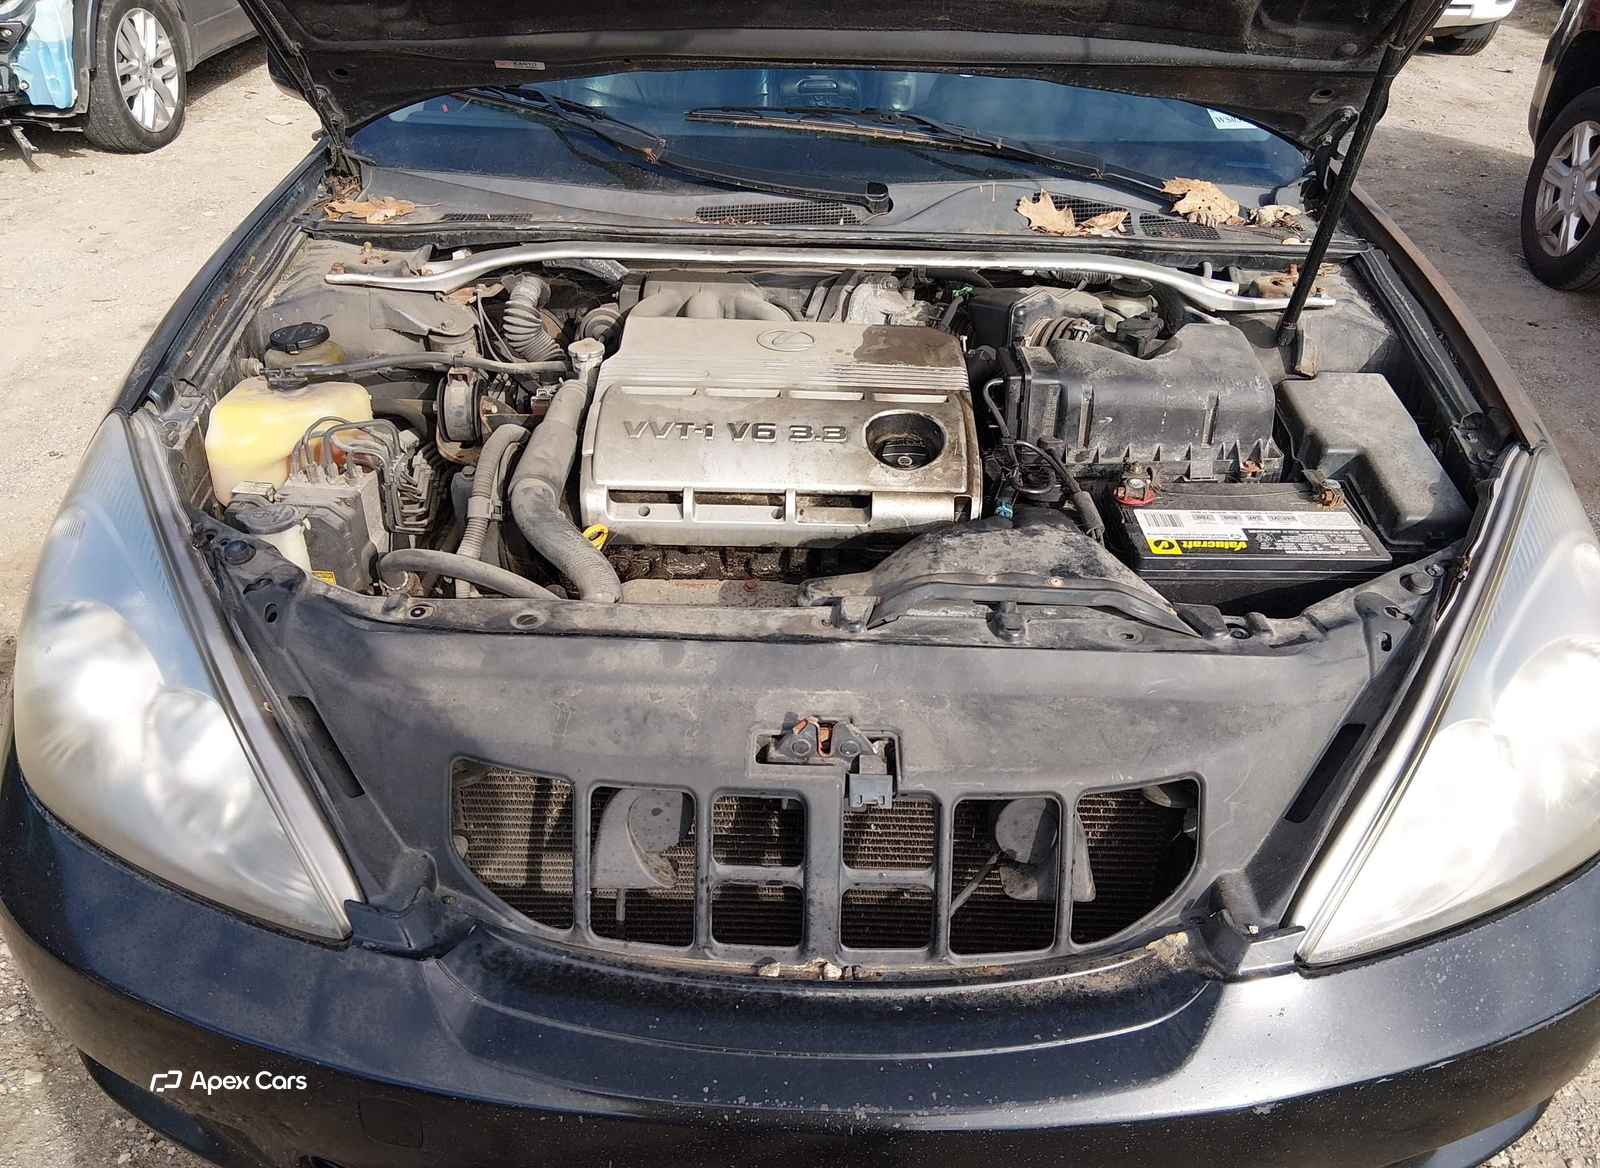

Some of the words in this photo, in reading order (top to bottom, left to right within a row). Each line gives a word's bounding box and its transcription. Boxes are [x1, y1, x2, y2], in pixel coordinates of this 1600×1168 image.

[727, 421, 777, 443] V6
[789, 424, 848, 443] 3.3
[1182, 541, 1248, 552] Valucraft
